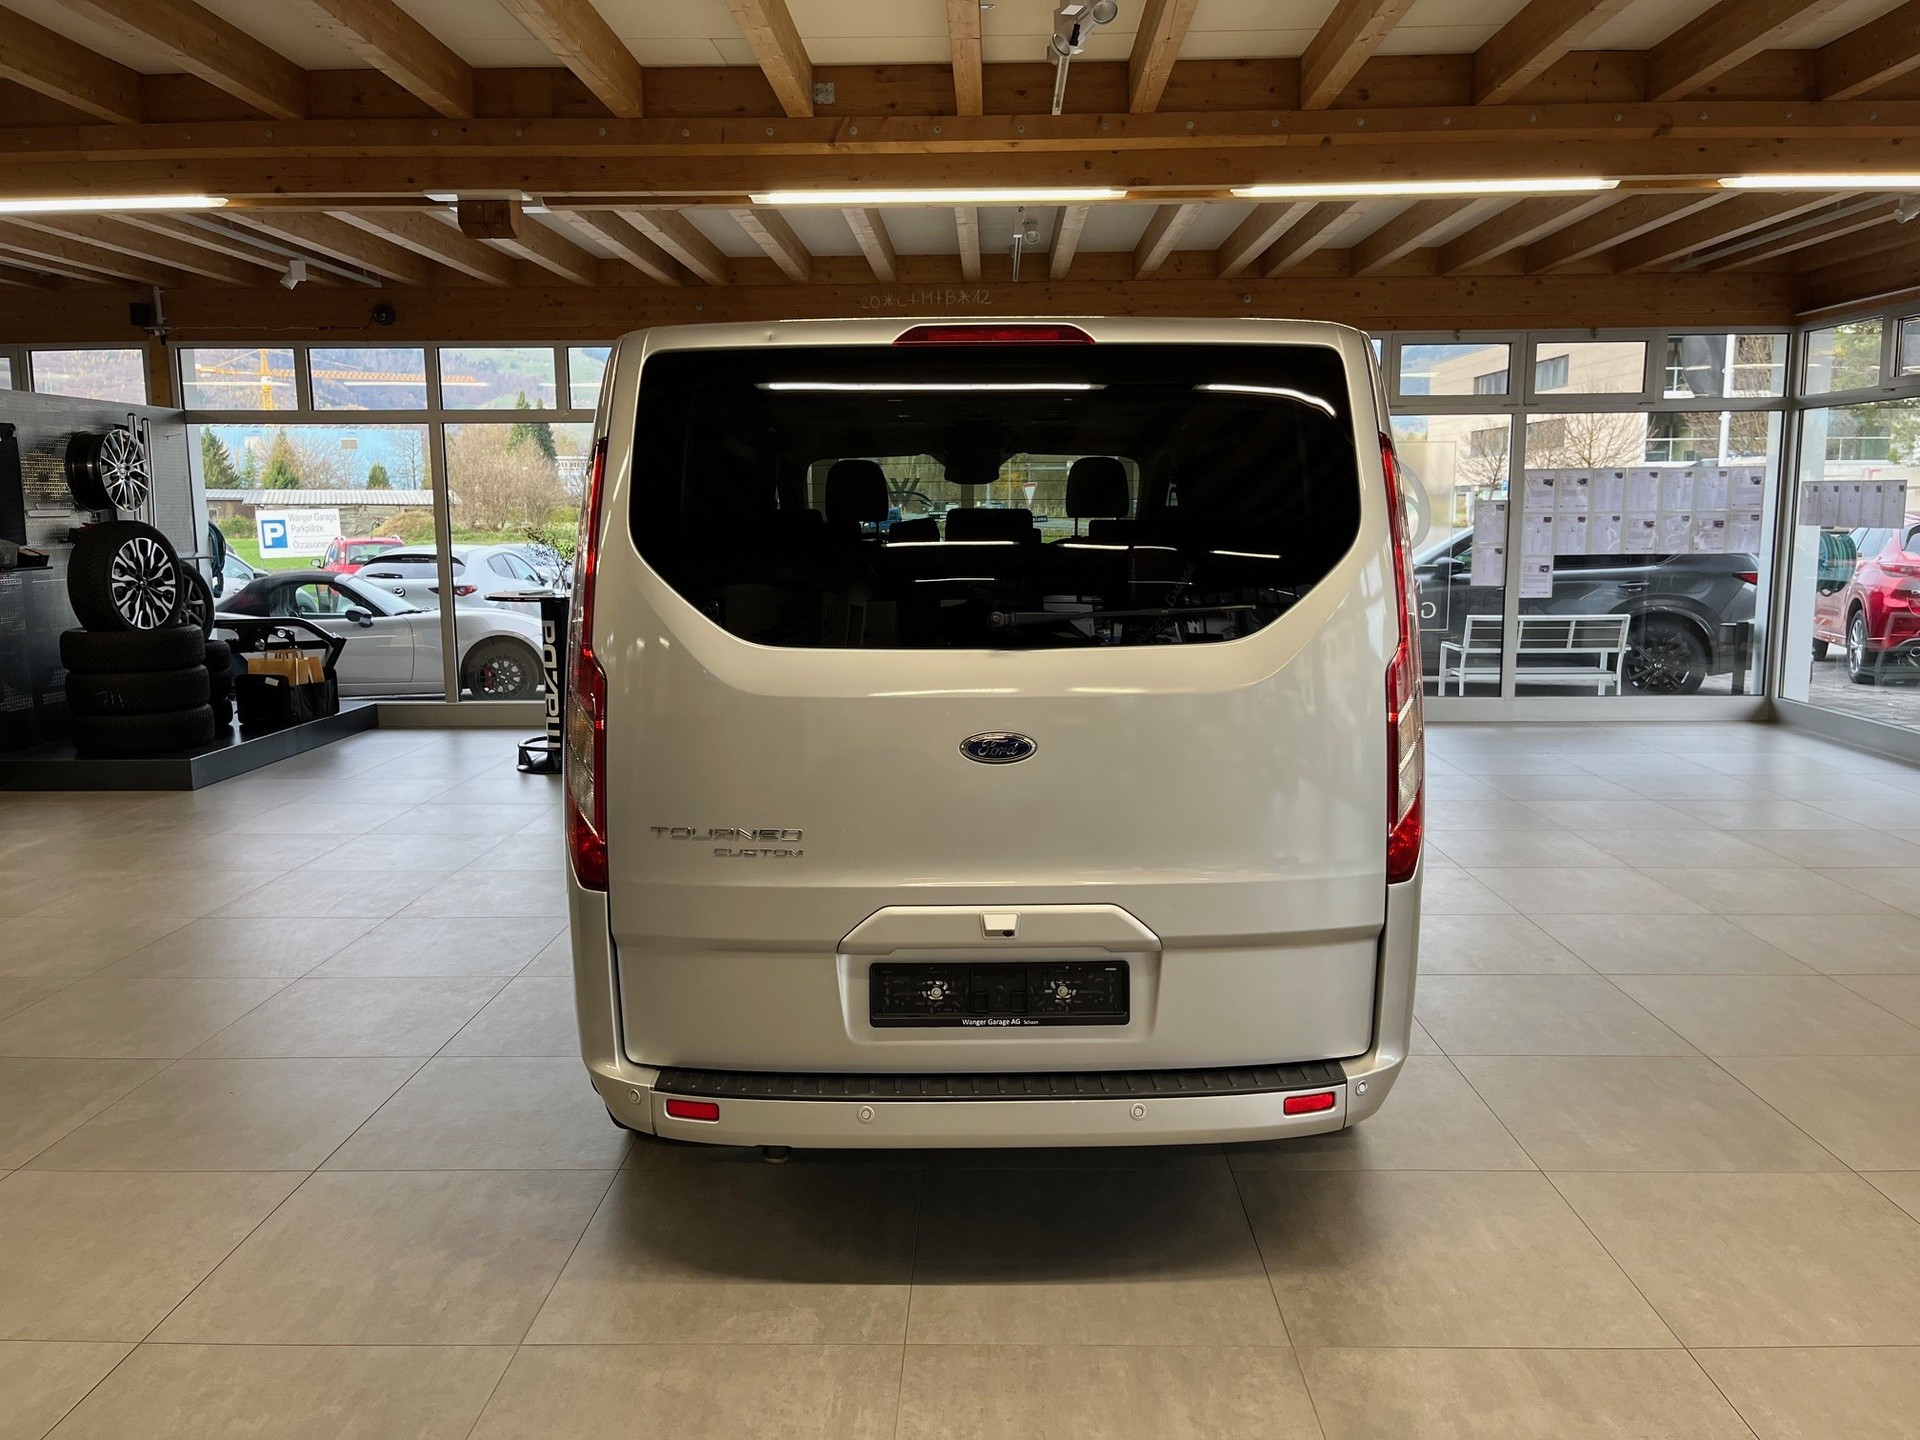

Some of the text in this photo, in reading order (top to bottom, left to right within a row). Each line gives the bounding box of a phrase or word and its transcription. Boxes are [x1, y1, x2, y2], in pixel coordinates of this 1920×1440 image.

[288, 512, 338, 523] Wanger Garage
[977, 739, 1019, 756] Ford
[650, 826, 804, 842] TOURNEO
[713, 848, 805, 859] CUSTOM
[962, 1018, 987, 1026] Wanger
[987, 1018, 1010, 1026] Garage
